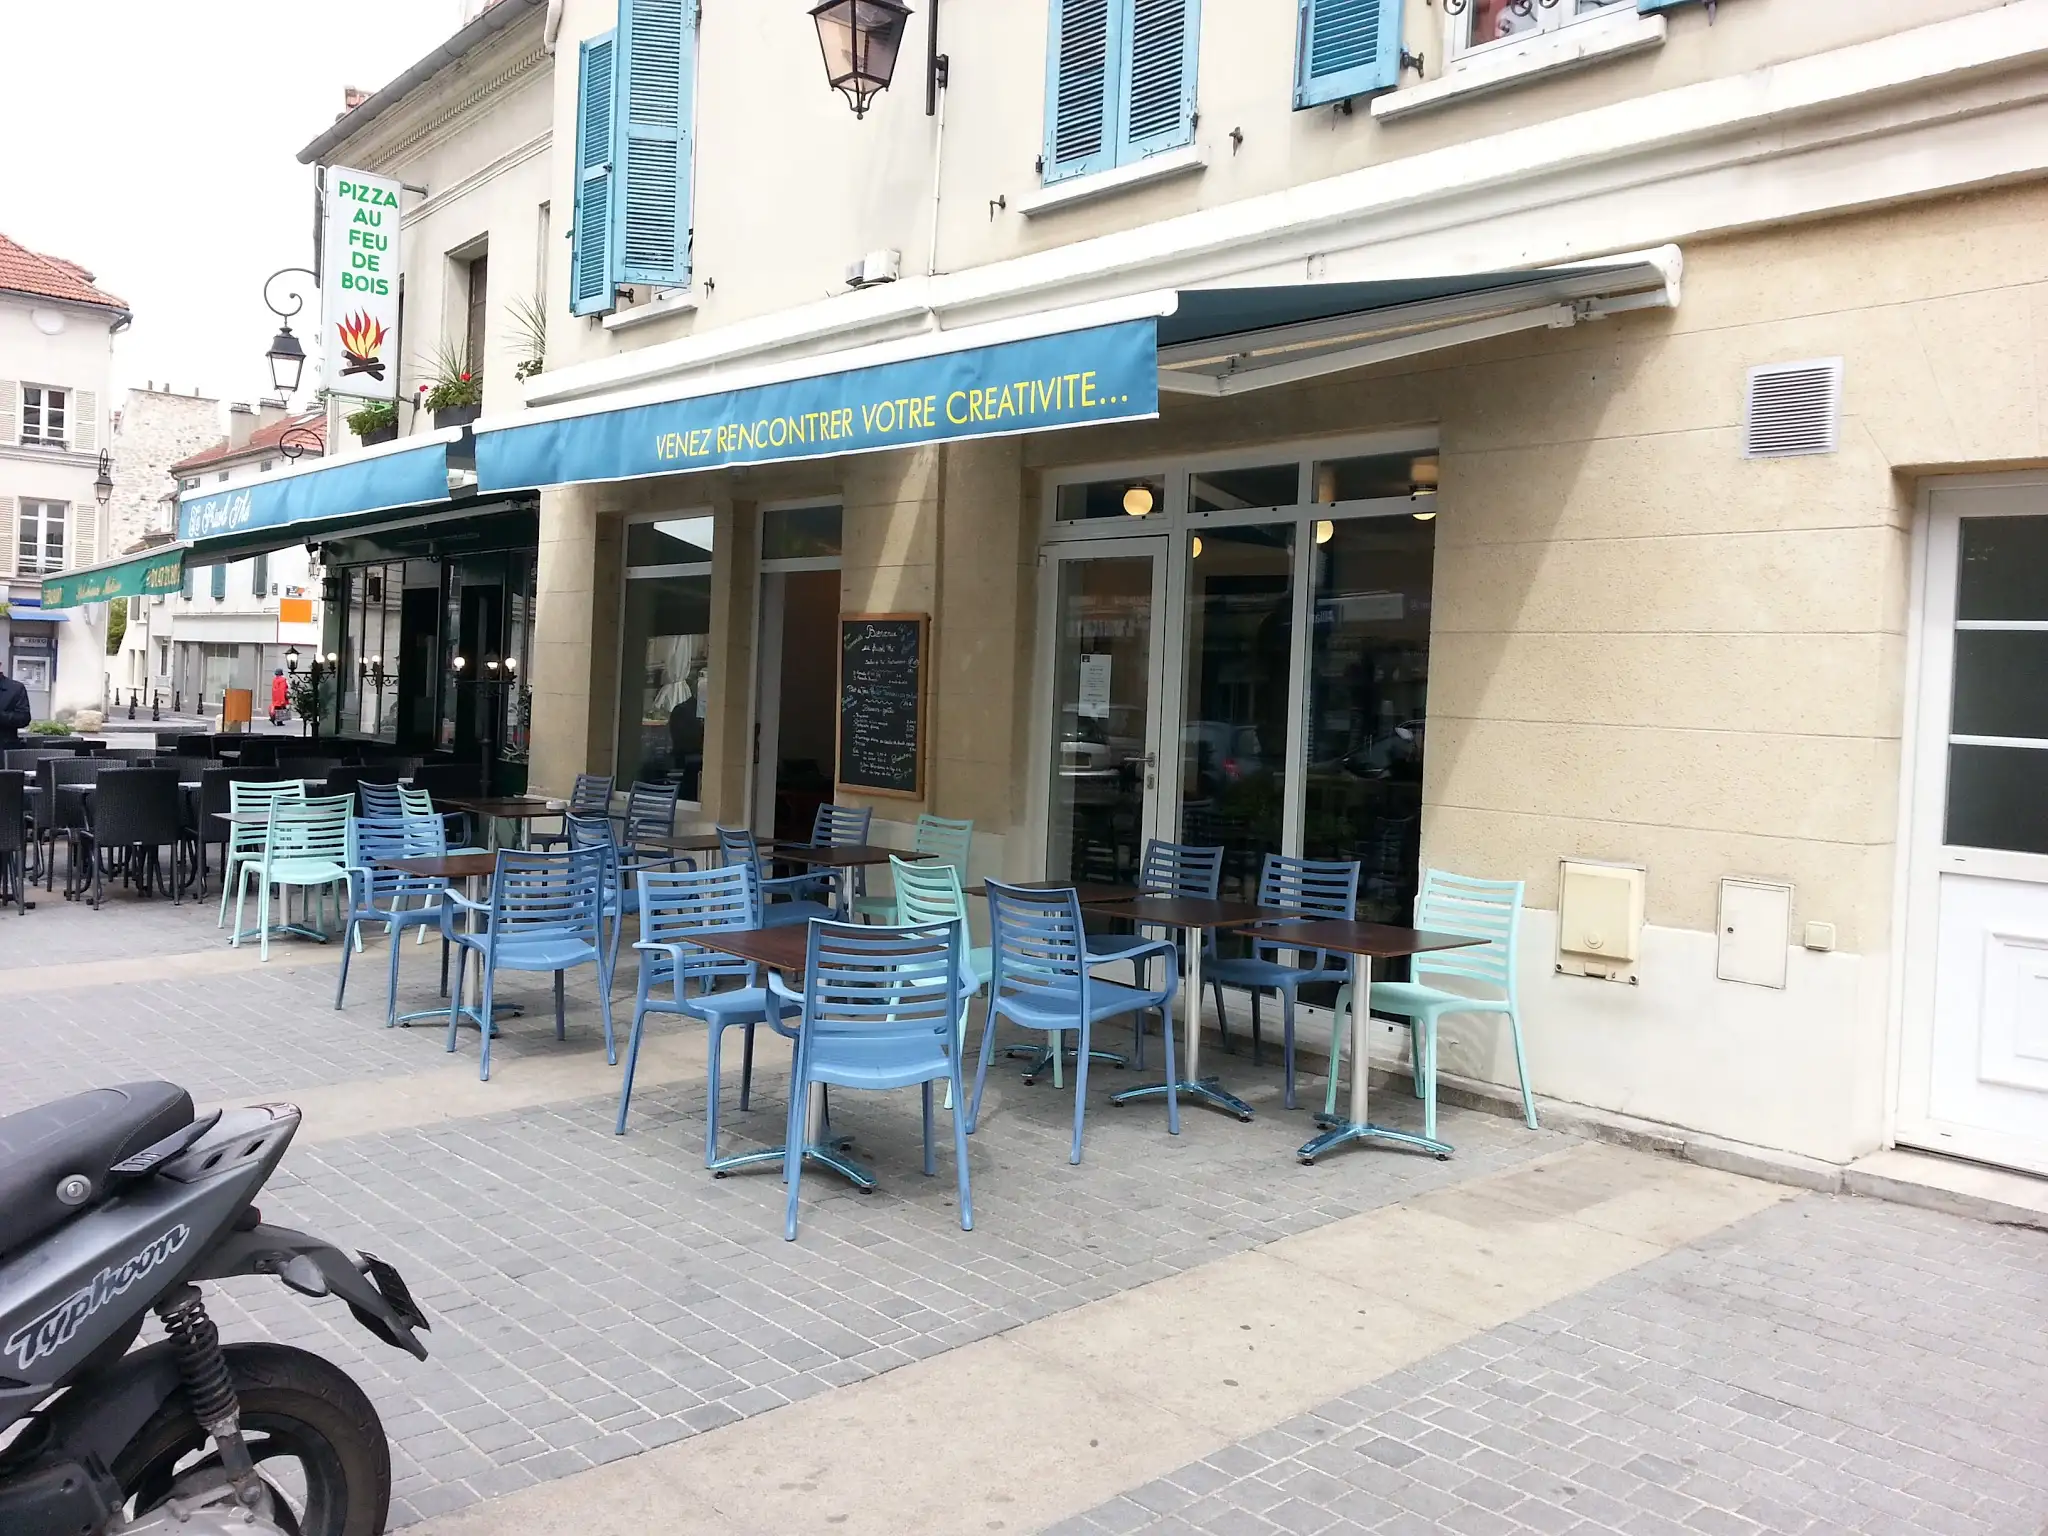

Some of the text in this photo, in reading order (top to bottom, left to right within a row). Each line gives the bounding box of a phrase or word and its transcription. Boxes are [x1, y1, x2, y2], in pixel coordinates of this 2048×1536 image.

[338, 180, 399, 209] PIZZA
[352, 207, 382, 227] AU
[348, 228, 388, 251] FEU
[351, 250, 380, 272] DE
[341, 271, 389, 296] BOIS
[655, 370, 1128, 461] VENEZ RENCONTRER VOTRE CREATIVITE...
[4, 1223, 190, 1370] Typhoon
